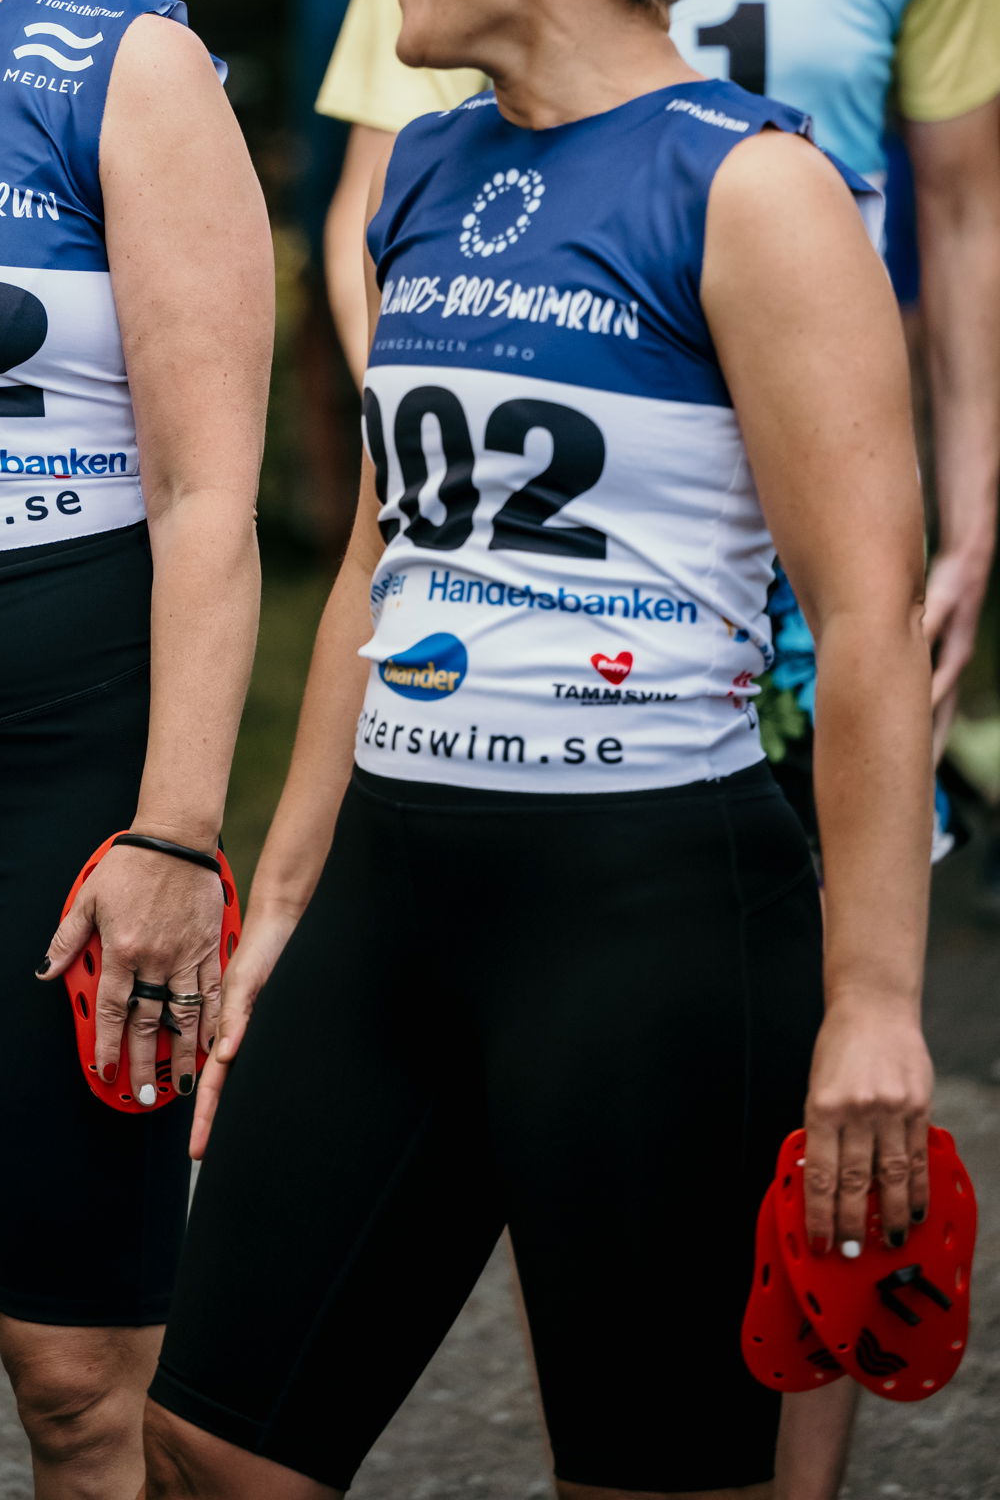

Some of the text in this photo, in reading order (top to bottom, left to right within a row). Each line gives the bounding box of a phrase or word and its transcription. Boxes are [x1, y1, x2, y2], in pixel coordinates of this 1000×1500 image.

[2, 68, 84, 95] MEDLEY
[493, 343, 535, 361] BRO
[428, 570, 698, 625] Handelsbanken
[383, 660, 461, 692] oander
[361, 708, 624, 766] derswim.se
